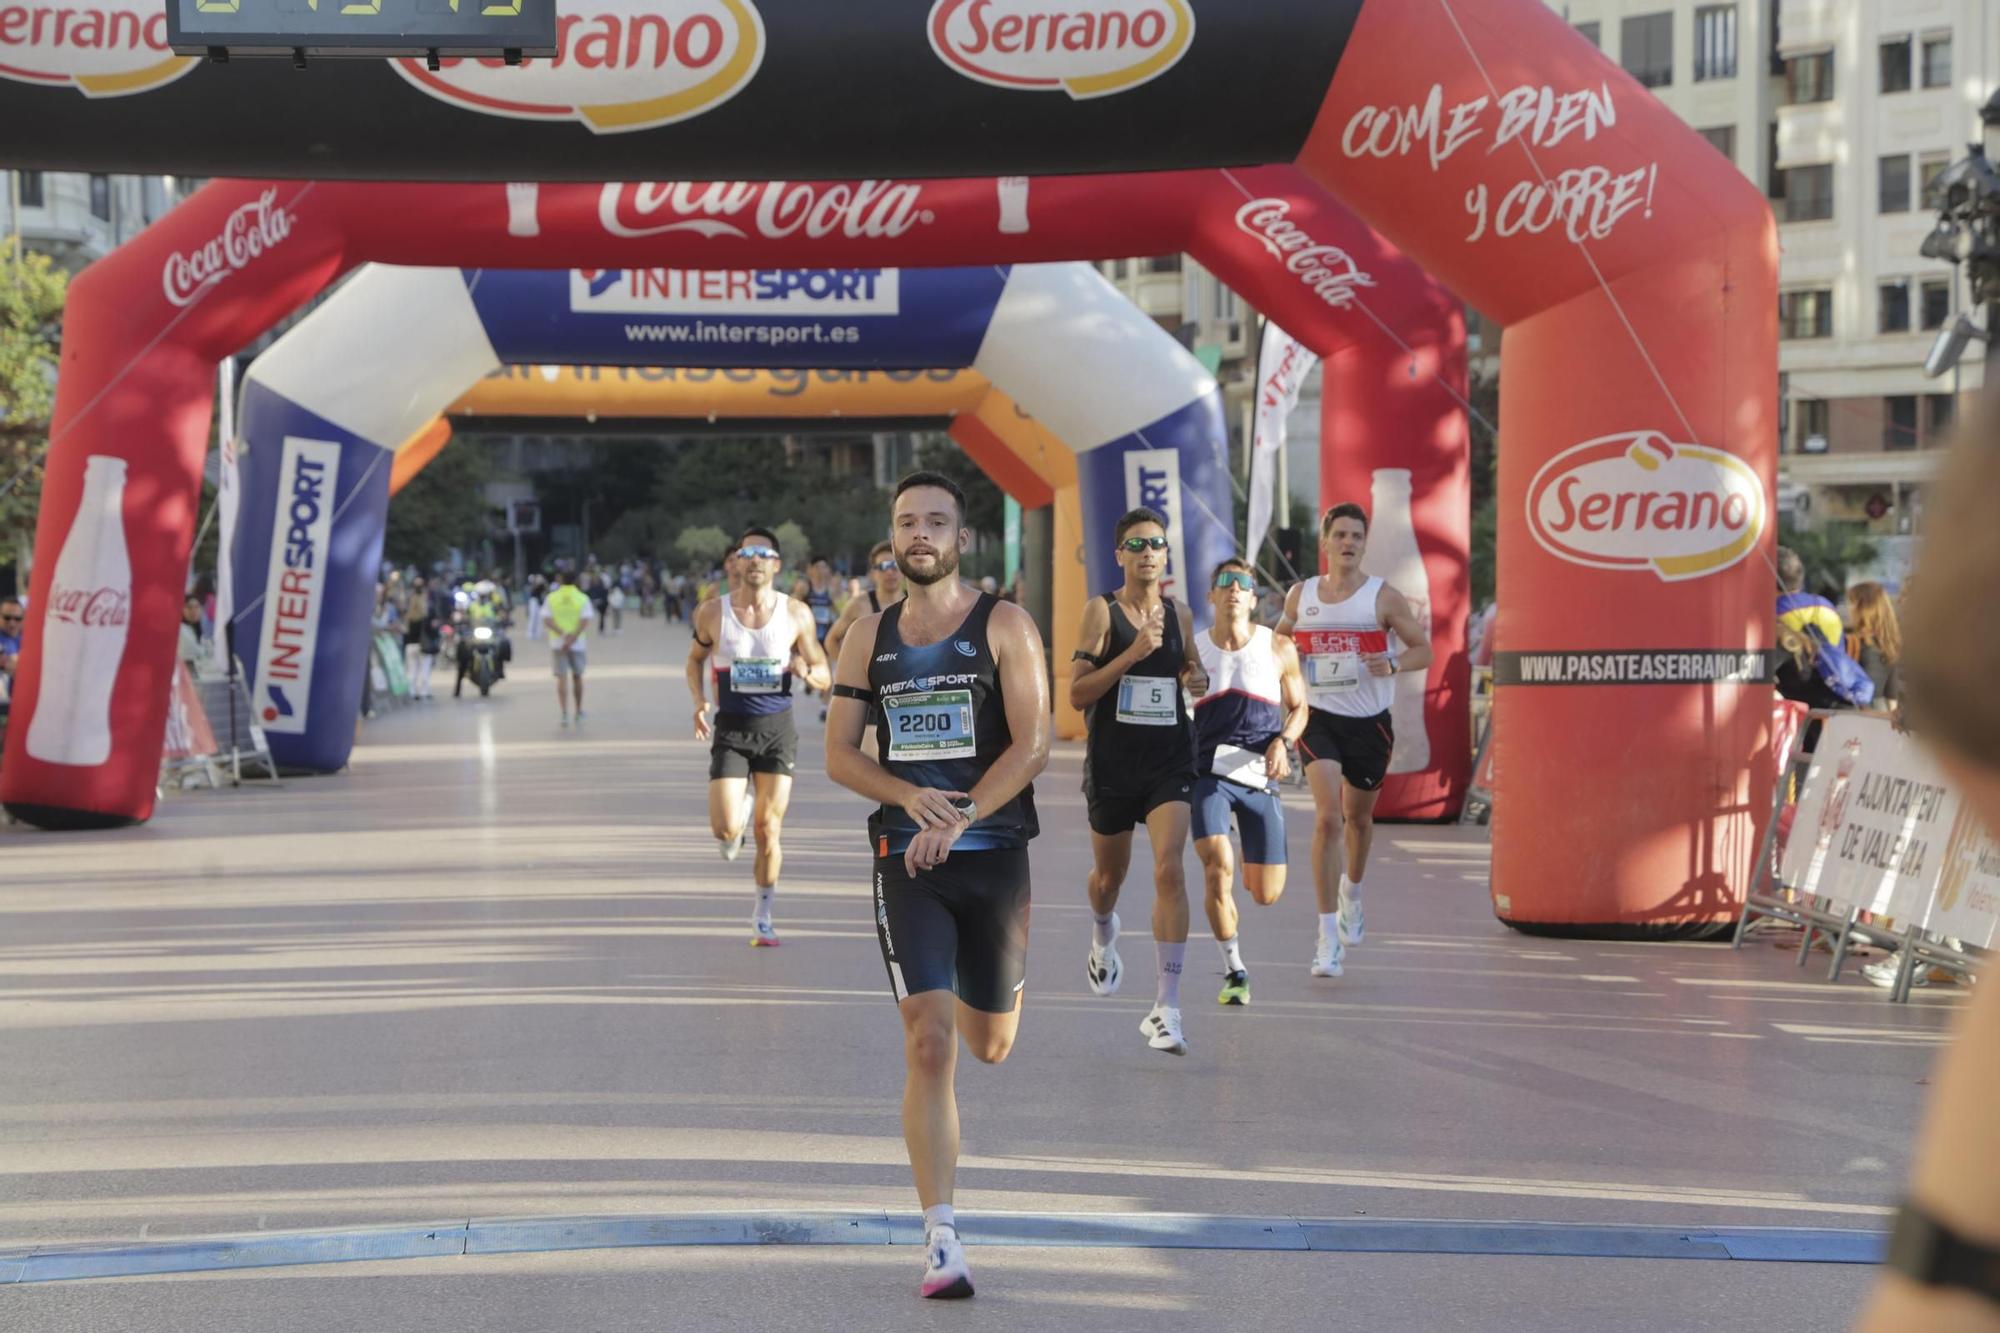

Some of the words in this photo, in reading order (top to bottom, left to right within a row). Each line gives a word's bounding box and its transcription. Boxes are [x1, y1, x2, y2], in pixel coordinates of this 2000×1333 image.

[0, 6, 169, 50] errano
[437, 13, 724, 69] rano
[957, 0, 1167, 54] Serrano
[1341, 83, 1490, 171] COME
[1485, 81, 1616, 155] BIEN
[1495, 162, 1658, 243] CORRE!
[630, 268, 882, 300] INTERSPORT
[625, 320, 860, 346] www.intersport.es
[1548, 475, 1749, 532] Serrano
[268, 453, 326, 681] INTERSPORT
[1330, 661, 1340, 675] 7
[1151, 687, 1162, 704] 5
[899, 713, 952, 733] 2200
[1840, 822, 1864, 861] DE
